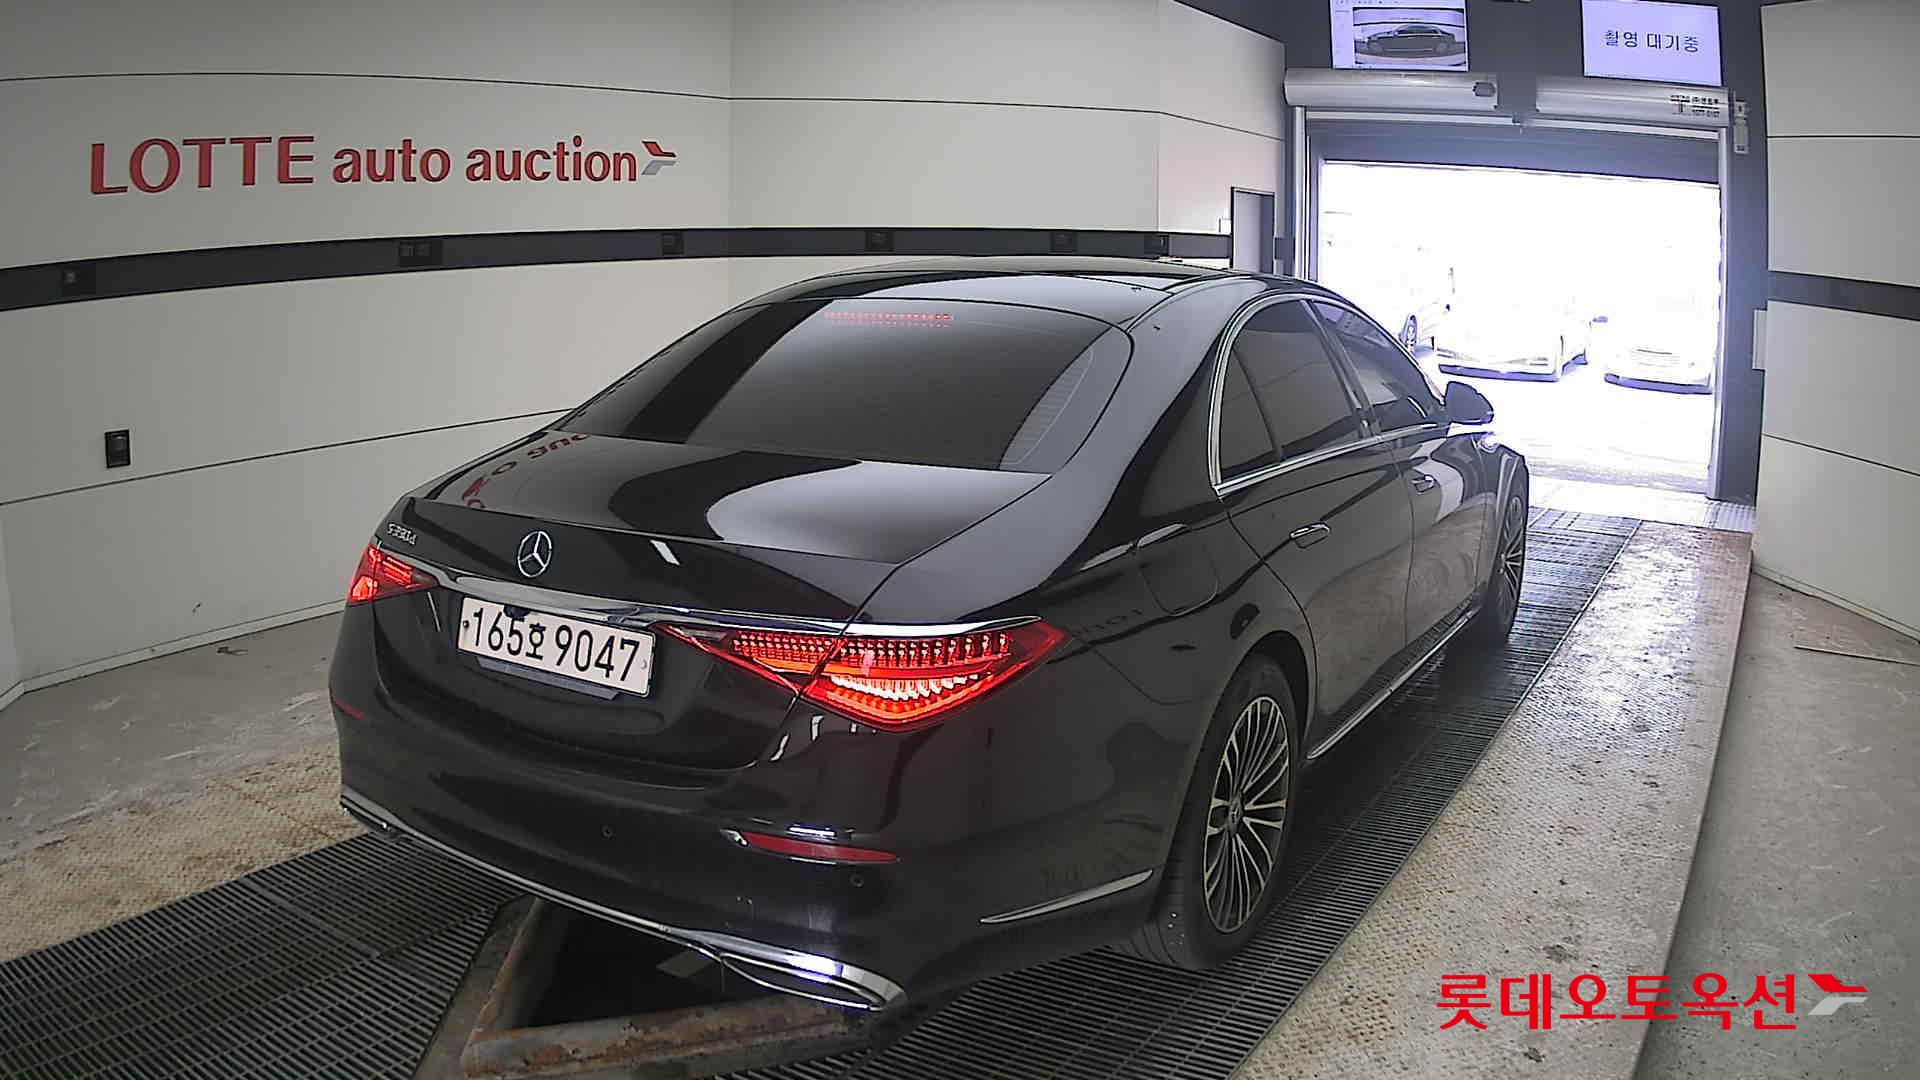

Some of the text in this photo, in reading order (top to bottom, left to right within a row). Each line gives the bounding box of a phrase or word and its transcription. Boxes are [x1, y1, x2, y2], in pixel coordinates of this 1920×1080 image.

[1647, 33, 1698, 53] 대기중
[91, 135, 637, 194] LOTTE auto auction
[555, 624, 640, 682] 9047
